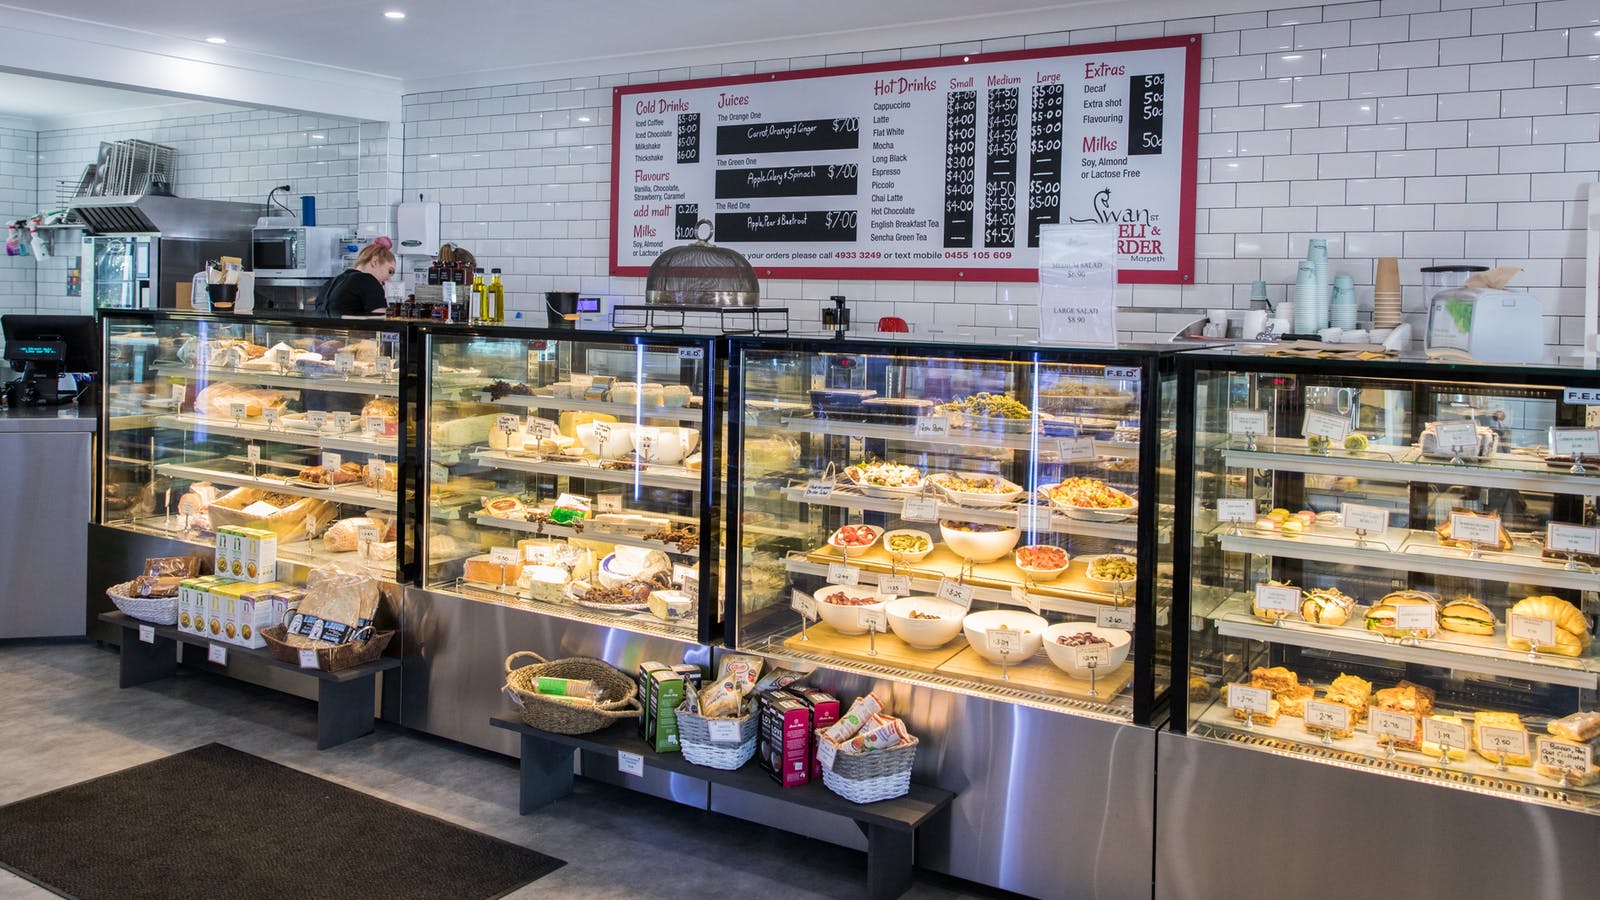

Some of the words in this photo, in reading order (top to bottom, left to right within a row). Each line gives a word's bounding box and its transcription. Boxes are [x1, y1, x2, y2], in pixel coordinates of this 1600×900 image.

[1085, 62, 1125, 79] Extras
[987, 74, 1021, 87] Medium
[1036, 72, 1061, 84] Large
[874, 79, 897, 96] Hot
[898, 76, 937, 95] Drinks
[949, 77, 974, 90] Small
[1084, 84, 1106, 93] Decaf
[717, 93, 750, 108] Juices
[1083, 99, 1103, 108] Extra
[1105, 99, 1122, 107] shot
[636, 99, 656, 115] Cold
[659, 98, 690, 114] Drinks
[873, 101, 911, 111] Cappuccino
[729, 113, 749, 122] Orange
[873, 115, 890, 124] Latte
[1083, 114, 1123, 123] Flavouring
[648, 119, 664, 127] Coffee
[647, 130, 672, 138] Chocolate
[873, 128, 885, 136] Flat
[886, 128, 904, 136] White
[872, 141, 894, 149] Mocha
[1083, 136, 1118, 153] Milks
[635, 154, 664, 162] Thickshake
[872, 155, 888, 164] Long
[889, 154, 907, 162] Black
[1081, 158, 1097, 168] Soy,
[1098, 157, 1128, 166] Almond
[635, 169, 670, 183] Flavours
[872, 168, 901, 177] Espresso
[1081, 171, 1089, 179] or
[1091, 170, 1120, 178] Lactose
[1123, 169, 1141, 178] Free
[871, 181, 895, 189] Piccolo
[663, 192, 686, 200] Caramel
[871, 194, 886, 202] Chai
[887, 194, 904, 202] Latte
[633, 204, 649, 217] add
[651, 204, 672, 217] malt
[716, 202, 726, 210] The
[871, 207, 882, 215] Hot
[884, 207, 915, 215] Chocolate
[870, 220, 894, 230] English
[895, 220, 927, 228] Breakfast
[928, 219, 939, 228] Tea
[633, 225, 657, 238] Milks
[1118, 224, 1146, 238] ELI
[1151, 225, 1161, 236] &
[870, 233, 894, 241] Sencha
[895, 233, 915, 241] Green
[916, 233, 928, 241] Tea
[644, 240, 663, 248] Almond
[1117, 240, 1163, 254] RDER
[791, 252, 817, 260] please
[835, 251, 857, 259] 4933
[859, 251, 881, 259] 3249
[913, 251, 942, 259] mobile
[944, 251, 969, 259] 0455
[972, 251, 990, 259] 105
[993, 251, 1012, 259] 609
[1130, 255, 1166, 263] Morpeth
[1076, 307, 1099, 315] SALAD
[1107, 370, 1137, 378] F.E.D.
